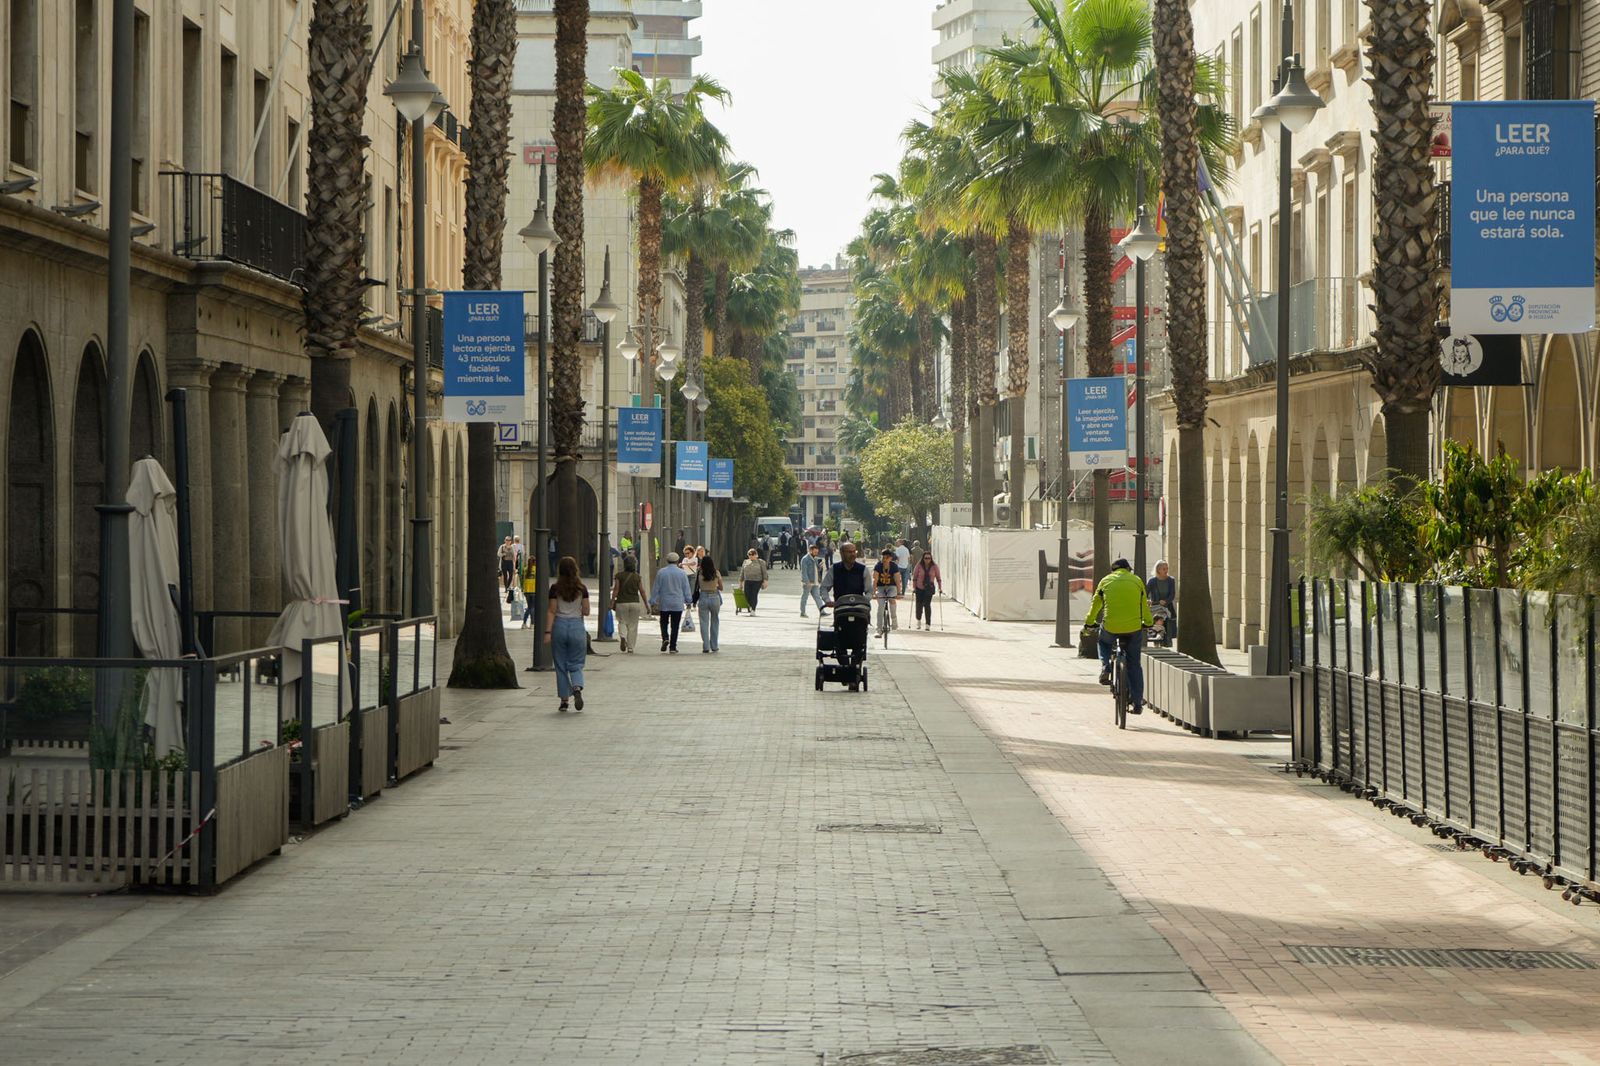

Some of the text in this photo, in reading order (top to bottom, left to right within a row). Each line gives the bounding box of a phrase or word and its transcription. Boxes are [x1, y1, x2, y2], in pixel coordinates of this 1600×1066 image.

[1495, 124, 1550, 143] LEER
[1495, 144, 1550, 157] ¿PARA QUÉ?
[1476, 189, 1569, 206] Una persona
[1469, 207, 1575, 224] que lee nunca
[1480, 224, 1564, 238] estará sola.
[468, 303, 500, 315] LEER
[457, 334, 511, 344] Una persona
[452, 344, 516, 353] lectora ejercita
[458, 353, 511, 362] 43 músculos
[468, 364, 500, 372] faciales
[457, 374, 511, 383] mientras lee.
[1084, 386, 1107, 394] LEER
[1093, 408, 1115, 416] ejercita
